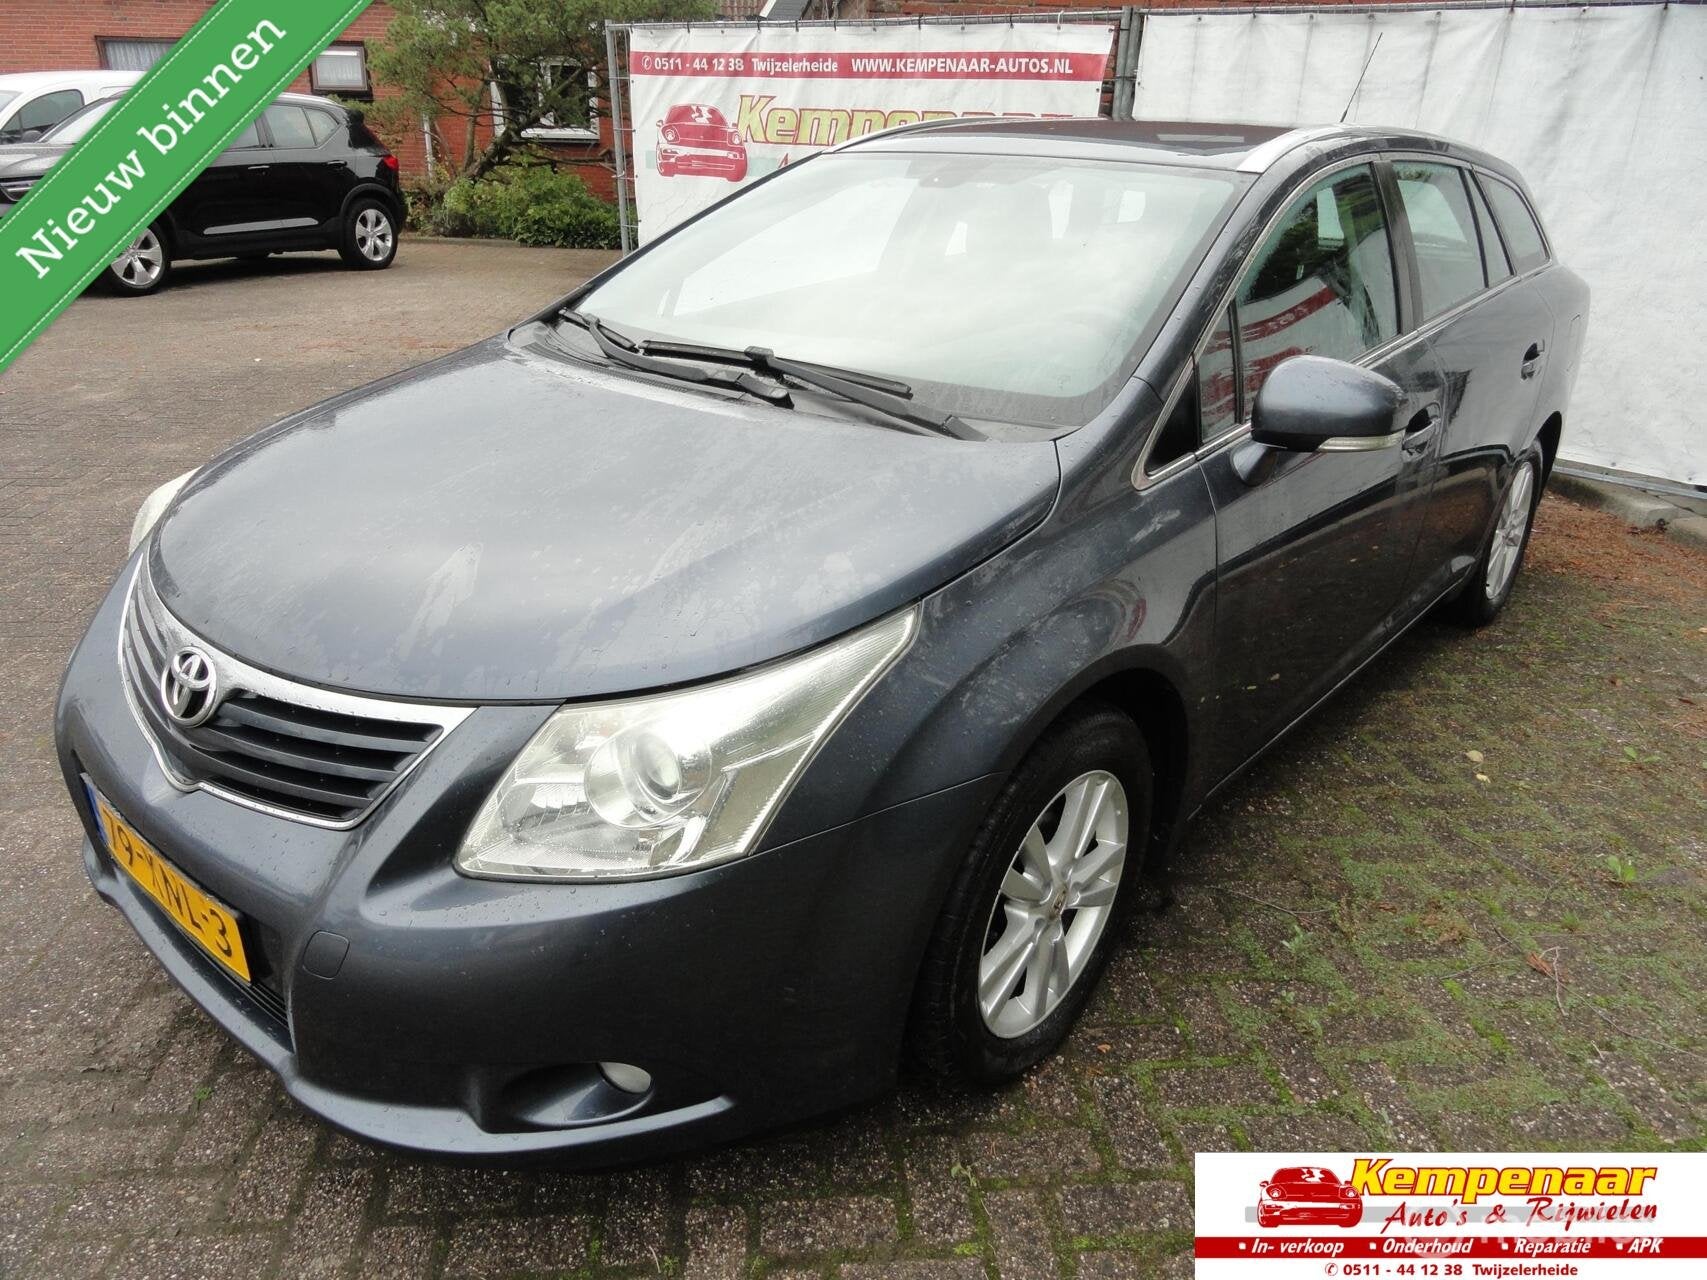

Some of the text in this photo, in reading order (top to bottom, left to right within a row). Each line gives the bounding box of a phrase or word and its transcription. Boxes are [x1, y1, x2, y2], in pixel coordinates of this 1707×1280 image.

[654, 57, 682, 71] 0511
[693, 58, 708, 71] 44
[712, 57, 724, 71] 12
[728, 58, 744, 71] 38
[752, 57, 838, 75] Twijzelerheide
[851, 57, 1073, 74] WWW.KEMPENAAR-AUTOS.NL
